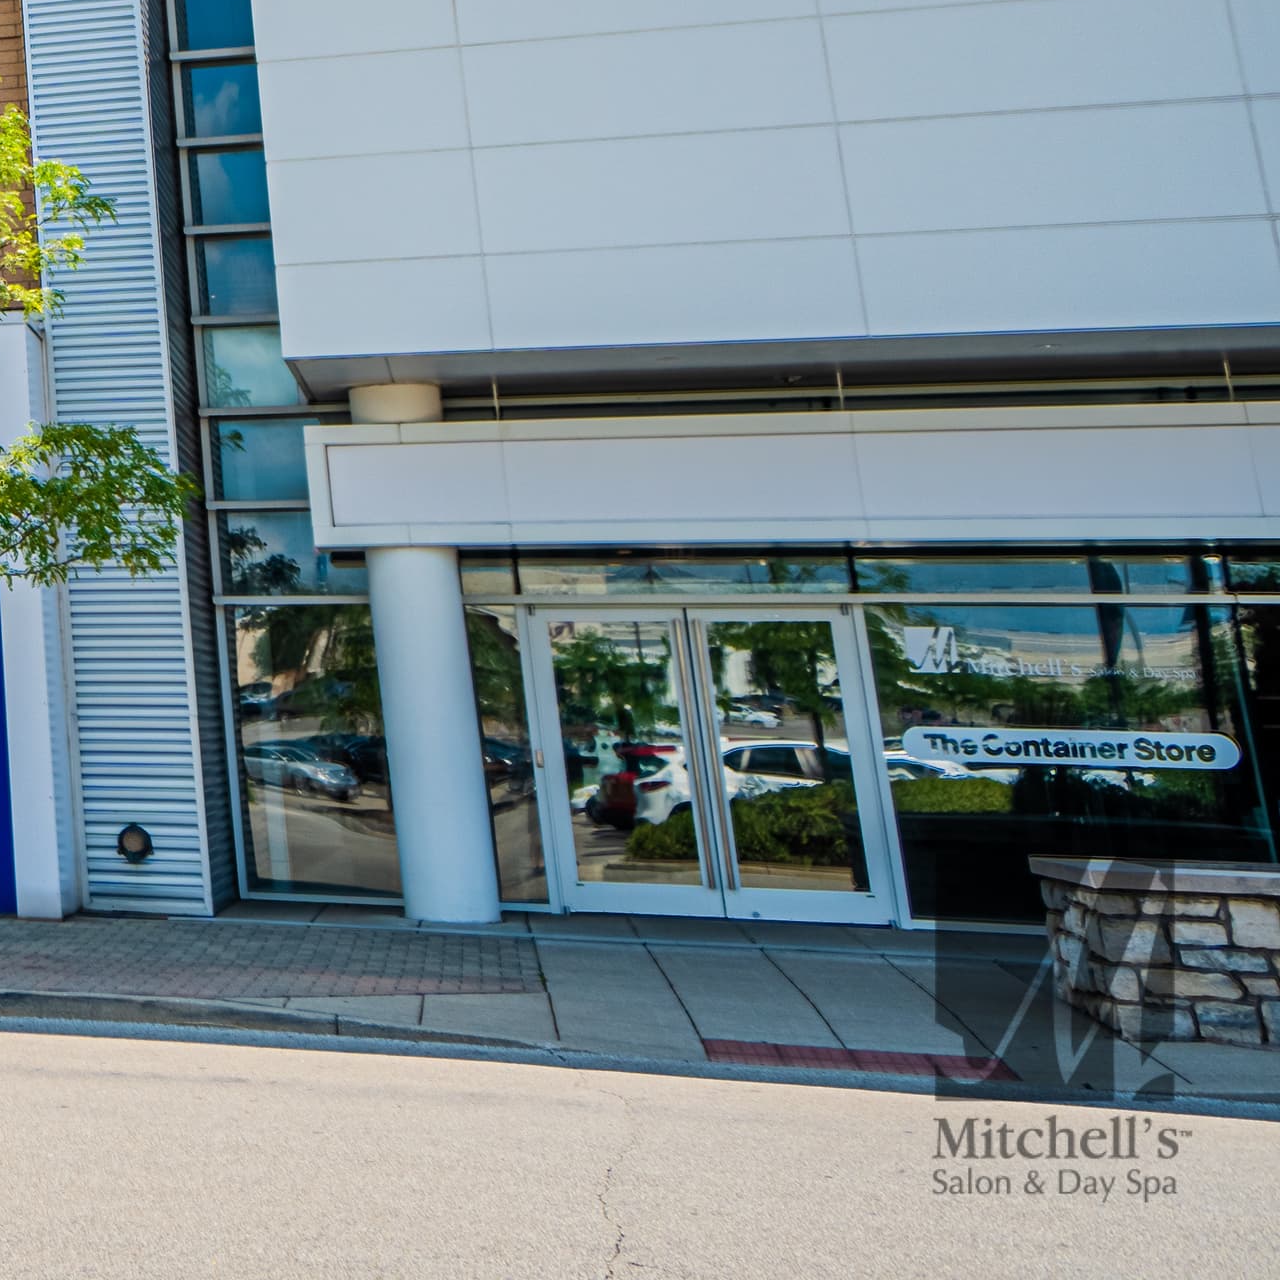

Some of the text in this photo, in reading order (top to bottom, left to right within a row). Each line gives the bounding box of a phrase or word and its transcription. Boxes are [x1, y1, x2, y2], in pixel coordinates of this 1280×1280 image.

[968, 658, 1082, 677] Mitchell's
[923, 733, 1217, 763] The Container Store
